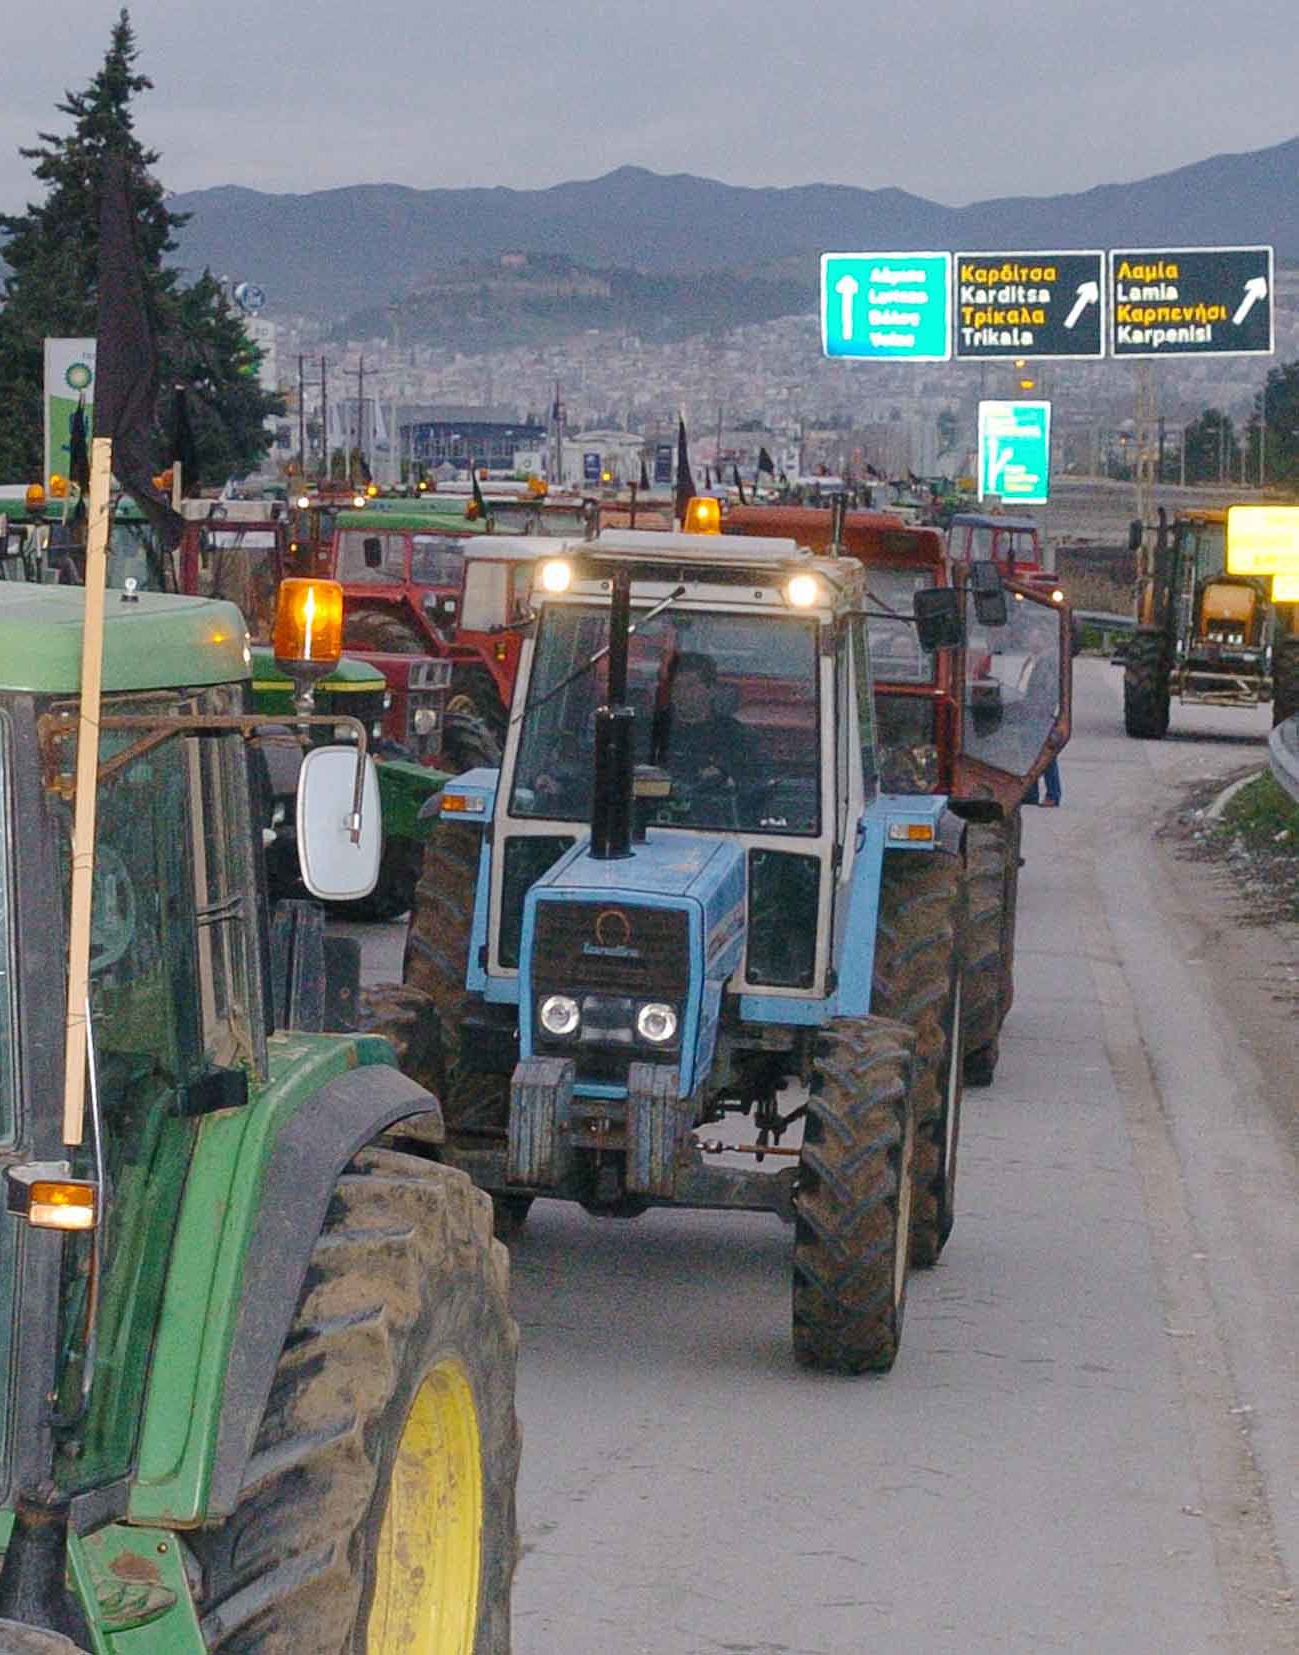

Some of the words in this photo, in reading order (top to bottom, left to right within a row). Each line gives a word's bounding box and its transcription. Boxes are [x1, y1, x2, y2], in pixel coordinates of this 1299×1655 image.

[961, 264, 1057, 287] Καρδίτσα
[1117, 261, 1179, 282] Λαμία
[961, 286, 1051, 304] Karditsa
[1117, 283, 1179, 301] Lamia
[962, 306, 1045, 328] Τρίκαλα
[1117, 303, 1227, 326] Καρπενήσι
[961, 328, 1034, 346] Trikala
[1117, 324, 1212, 347] Karpenisi
